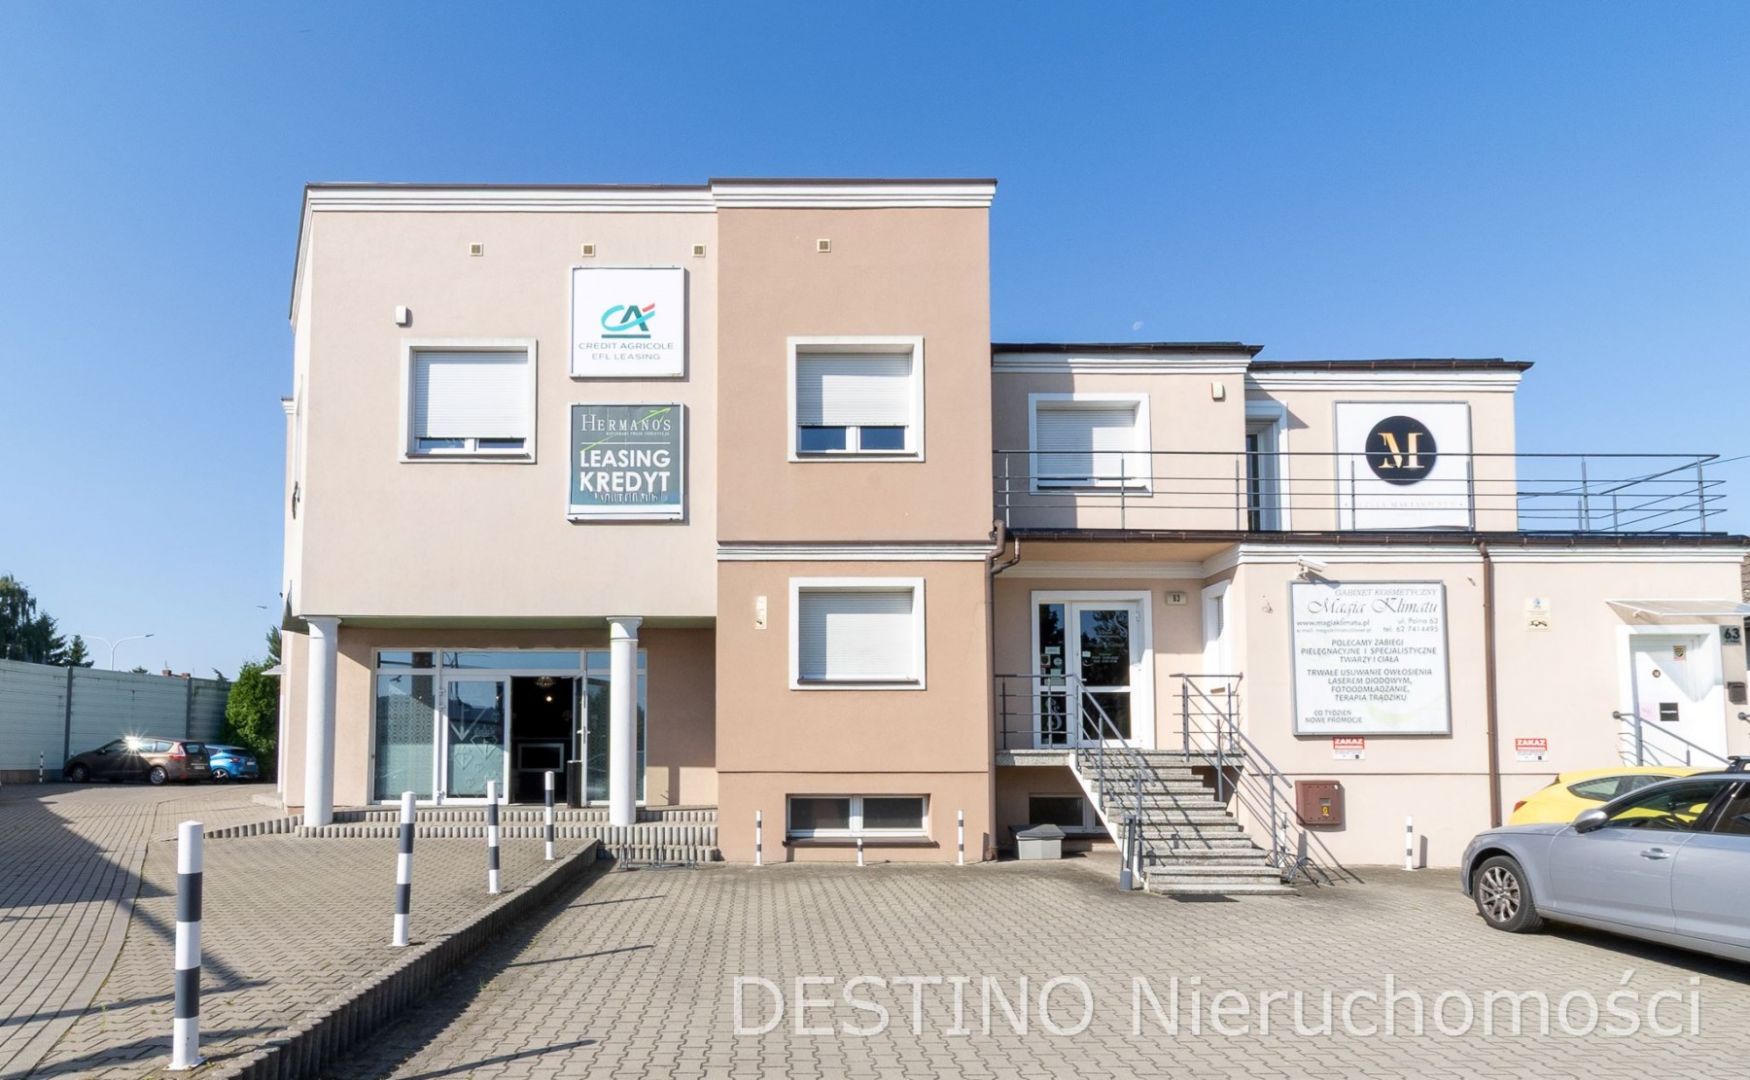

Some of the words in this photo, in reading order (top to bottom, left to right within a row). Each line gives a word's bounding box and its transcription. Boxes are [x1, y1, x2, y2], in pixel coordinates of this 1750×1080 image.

[578, 342, 617, 351] CREDIT
[620, 342, 674, 351] AGRICOLE
[592, 353, 610, 361] EFL
[614, 353, 661, 361] LEASING
[1377, 431, 1425, 469] M
[580, 449, 671, 468] LEASING
[580, 471, 671, 493] KREDYT
[1307, 598, 1367, 616] Magia
[1371, 597, 1438, 614] Klimatu
[1724, 627, 1740, 640] 63
[1331, 639, 1372, 647] POLECAMY
[1374, 639, 1404, 647] ZABIEGI
[1301, 648, 1360, 656] PIELĘGNACYJNE
[1370, 648, 1436, 656] SPECJALISTYCZNE
[1340, 656, 1371, 664] TWARZY
[1307, 669, 1338, 677] TRWAŁE
[1384, 668, 1432, 676] OWŁOSIENIA
[1365, 677, 1412, 685] DIODOWYM,
[1335, 694, 1367, 702] TERAPIA
[1369, 694, 1407, 703] TRĄDZIKU
